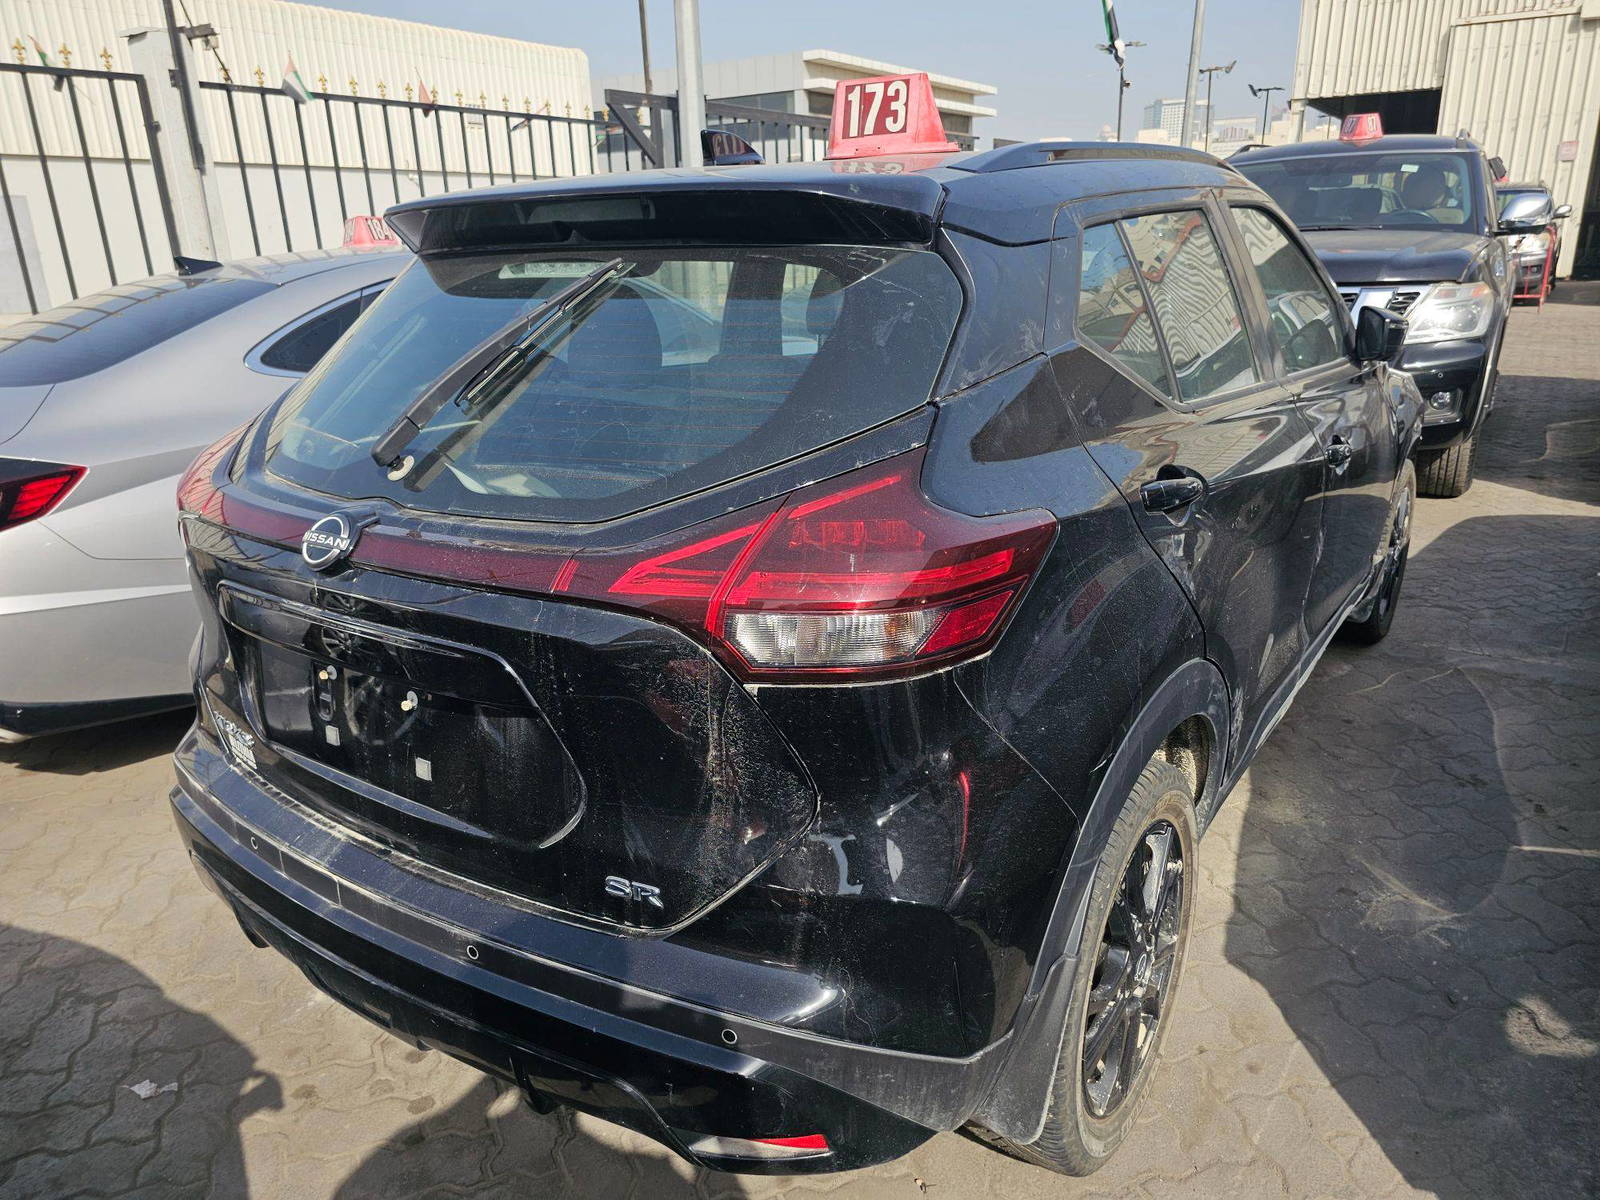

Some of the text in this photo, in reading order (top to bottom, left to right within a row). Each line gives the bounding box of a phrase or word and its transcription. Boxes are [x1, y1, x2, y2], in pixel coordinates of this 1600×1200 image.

[847, 80, 908, 138] 173
[302, 530, 351, 550] NISSAN
[605, 875, 664, 910] SR
